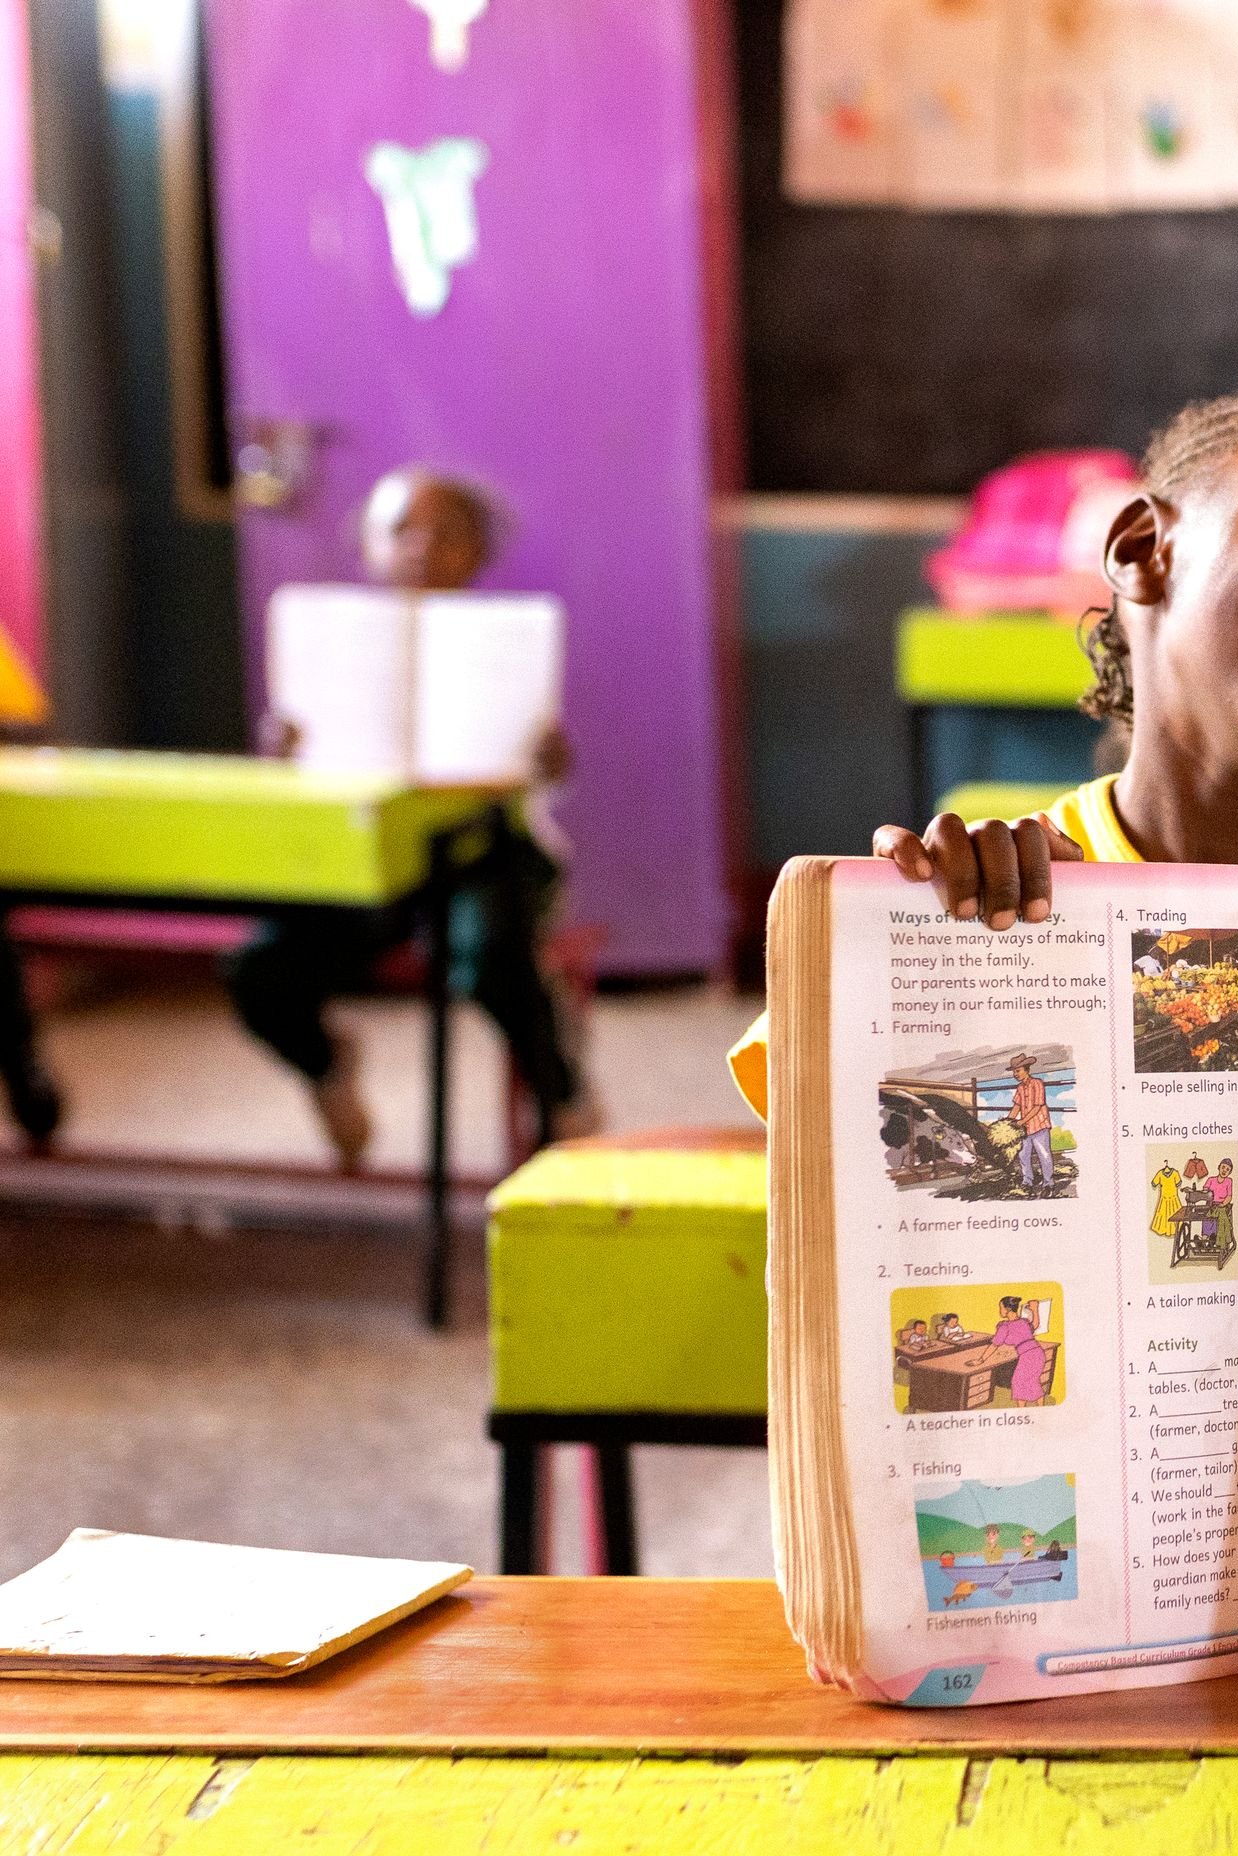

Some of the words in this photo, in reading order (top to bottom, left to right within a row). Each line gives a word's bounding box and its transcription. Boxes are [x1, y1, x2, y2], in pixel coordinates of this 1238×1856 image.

[890, 911, 930, 924] Ways
[1137, 909, 1187, 924] Trading
[890, 933, 914, 945] We
[919, 931, 951, 944] have
[956, 934, 993, 947] many
[998, 934, 1033, 946] ways
[1056, 930, 1105, 946] making
[891, 956, 937, 970] money
[960, 955, 982, 967] the
[987, 954, 1035, 969] family.
[891, 977, 917, 989] Our
[922, 977, 975, 991] parents
[979, 975, 1013, 987] work
[1017, 975, 1049, 987] hard
[1053, 976, 1067, 987] to
[1070, 974, 1106, 986] make
[893, 1001, 938, 1014] money
[960, 999, 983, 1010] our
[988, 997, 1042, 1010] families
[1046, 996, 1106, 1011] through;
[893, 1021, 951, 1036] Farming
[1141, 1082, 1183, 1096] People
[1187, 1080, 1224, 1095] selling
[1143, 1123, 1188, 1138] Making
[1192, 1122, 1232, 1135] clothes
[913, 1218, 962, 1232] farmer
[967, 1216, 1018, 1231] feeding
[1024, 1217, 1063, 1227] cows.
[904, 1262, 973, 1277] Teaching.
[1160, 1294, 1193, 1308] tailor
[1197, 1292, 1235, 1306] making
[1148, 1338, 1198, 1352] Activity
[1149, 1381, 1190, 1395] tables.
[1194, 1378, 1238, 1393] (doctor,
[921, 1416, 974, 1431] teacher
[996, 1413, 1035, 1426] class.
[1150, 1425, 1200, 1440] (farmer,
[912, 1462, 962, 1476] Fishing
[1151, 1468, 1200, 1482] (farmer,
[1205, 1460, 1238, 1475] tailor)
[1152, 1490, 1172, 1502] We
[1175, 1484, 1212, 1500] should
[1152, 1510, 1186, 1526] (work
[1206, 1506, 1223, 1518] the
[1153, 1528, 1201, 1548] people's
[1153, 1553, 1180, 1567] How
[1184, 1548, 1209, 1563] does
[1213, 1548, 1235, 1562] your
[1153, 1572, 1207, 1591] guardian
[1210, 1568, 1236, 1581] make
[1154, 1595, 1191, 1610] family
[1194, 1588, 1230, 1605] needs?
[927, 1616, 992, 1631] Fishermen
[995, 1610, 1037, 1624] fishing
[943, 1674, 973, 1691] 162
